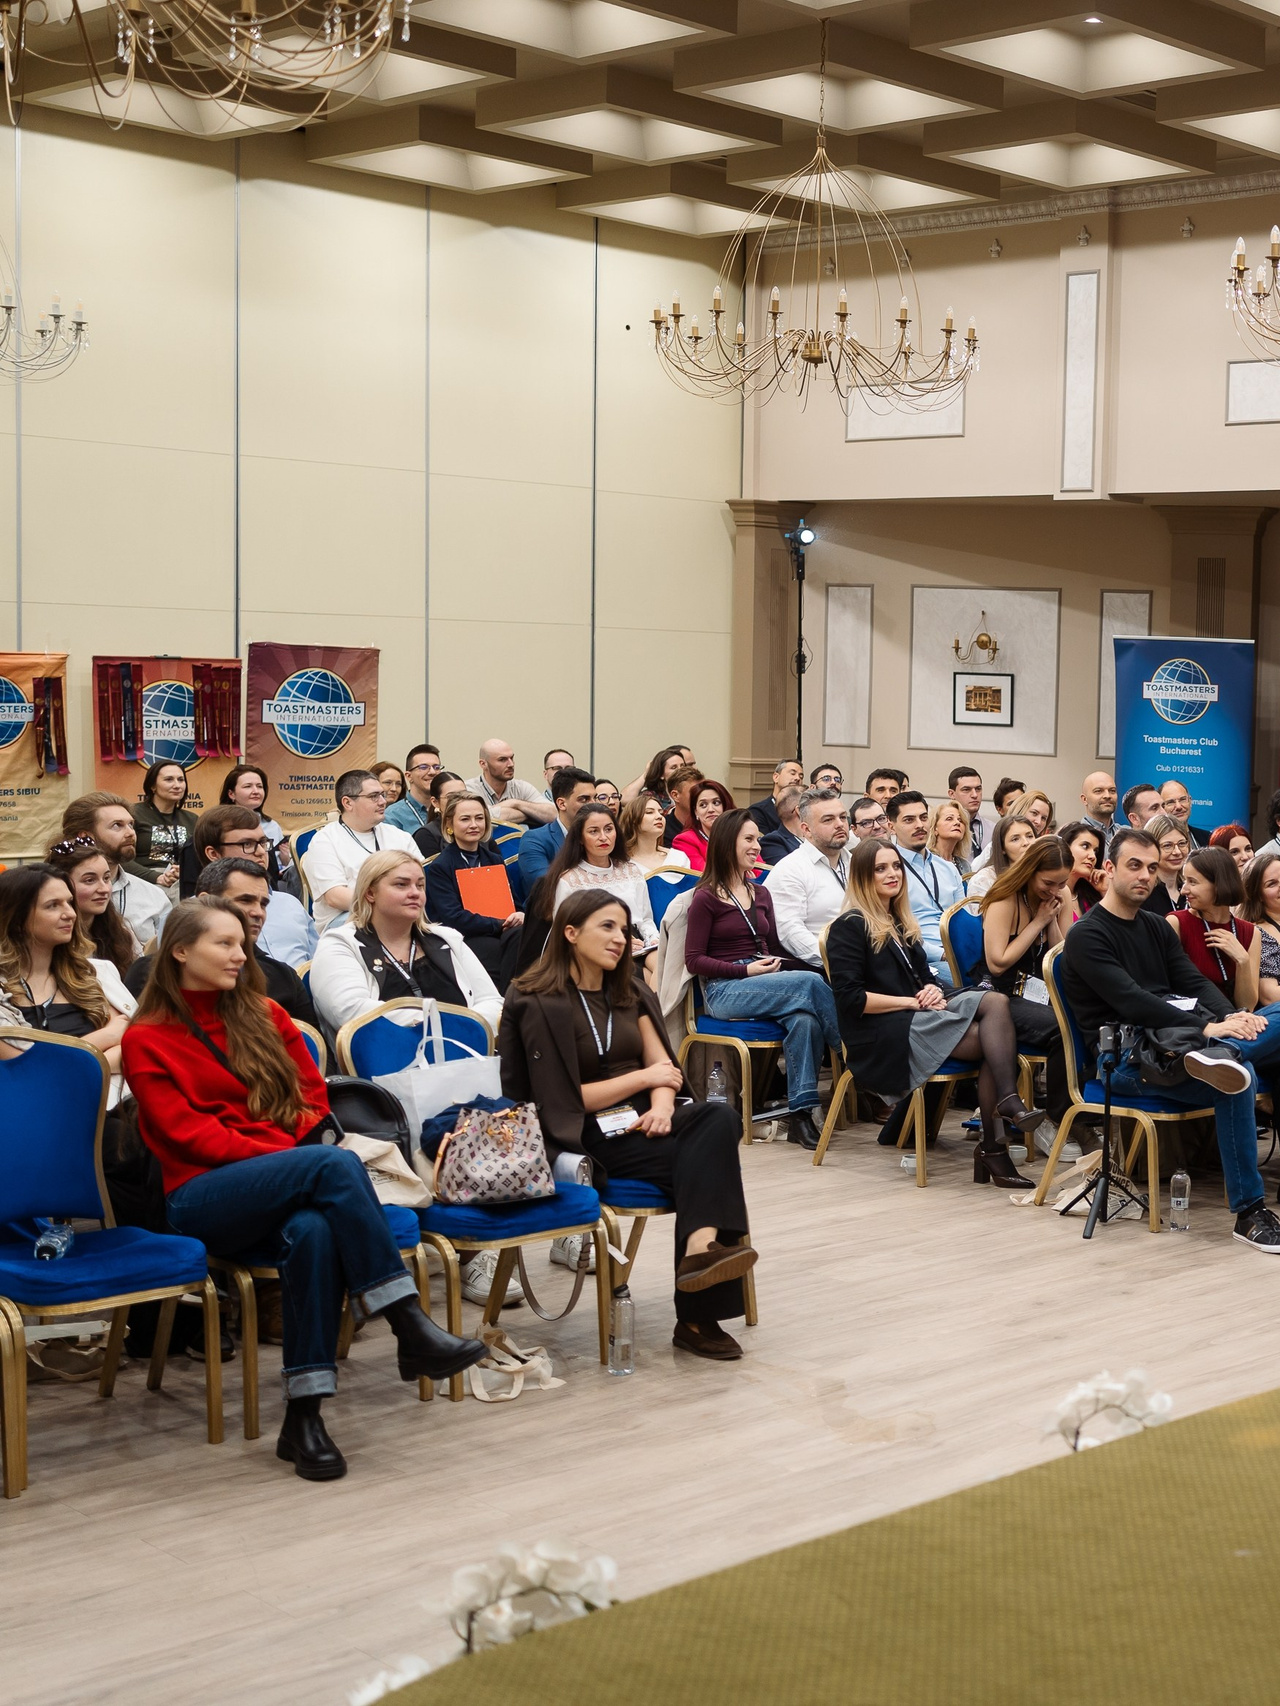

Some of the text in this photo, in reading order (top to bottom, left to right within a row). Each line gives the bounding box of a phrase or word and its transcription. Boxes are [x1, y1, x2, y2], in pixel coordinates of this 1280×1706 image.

[1146, 684, 1216, 694] TOASTMASTERS
[266, 703, 362, 716] TOASTMASTERS
[276, 714, 351, 723] INTERNATIONAL
[1143, 735, 1219, 746] Toastmasters Club
[1160, 746, 1202, 756] Bucharest
[1155, 764, 1204, 774] Club 01216331
[17, 788, 41, 796] SIBIU
